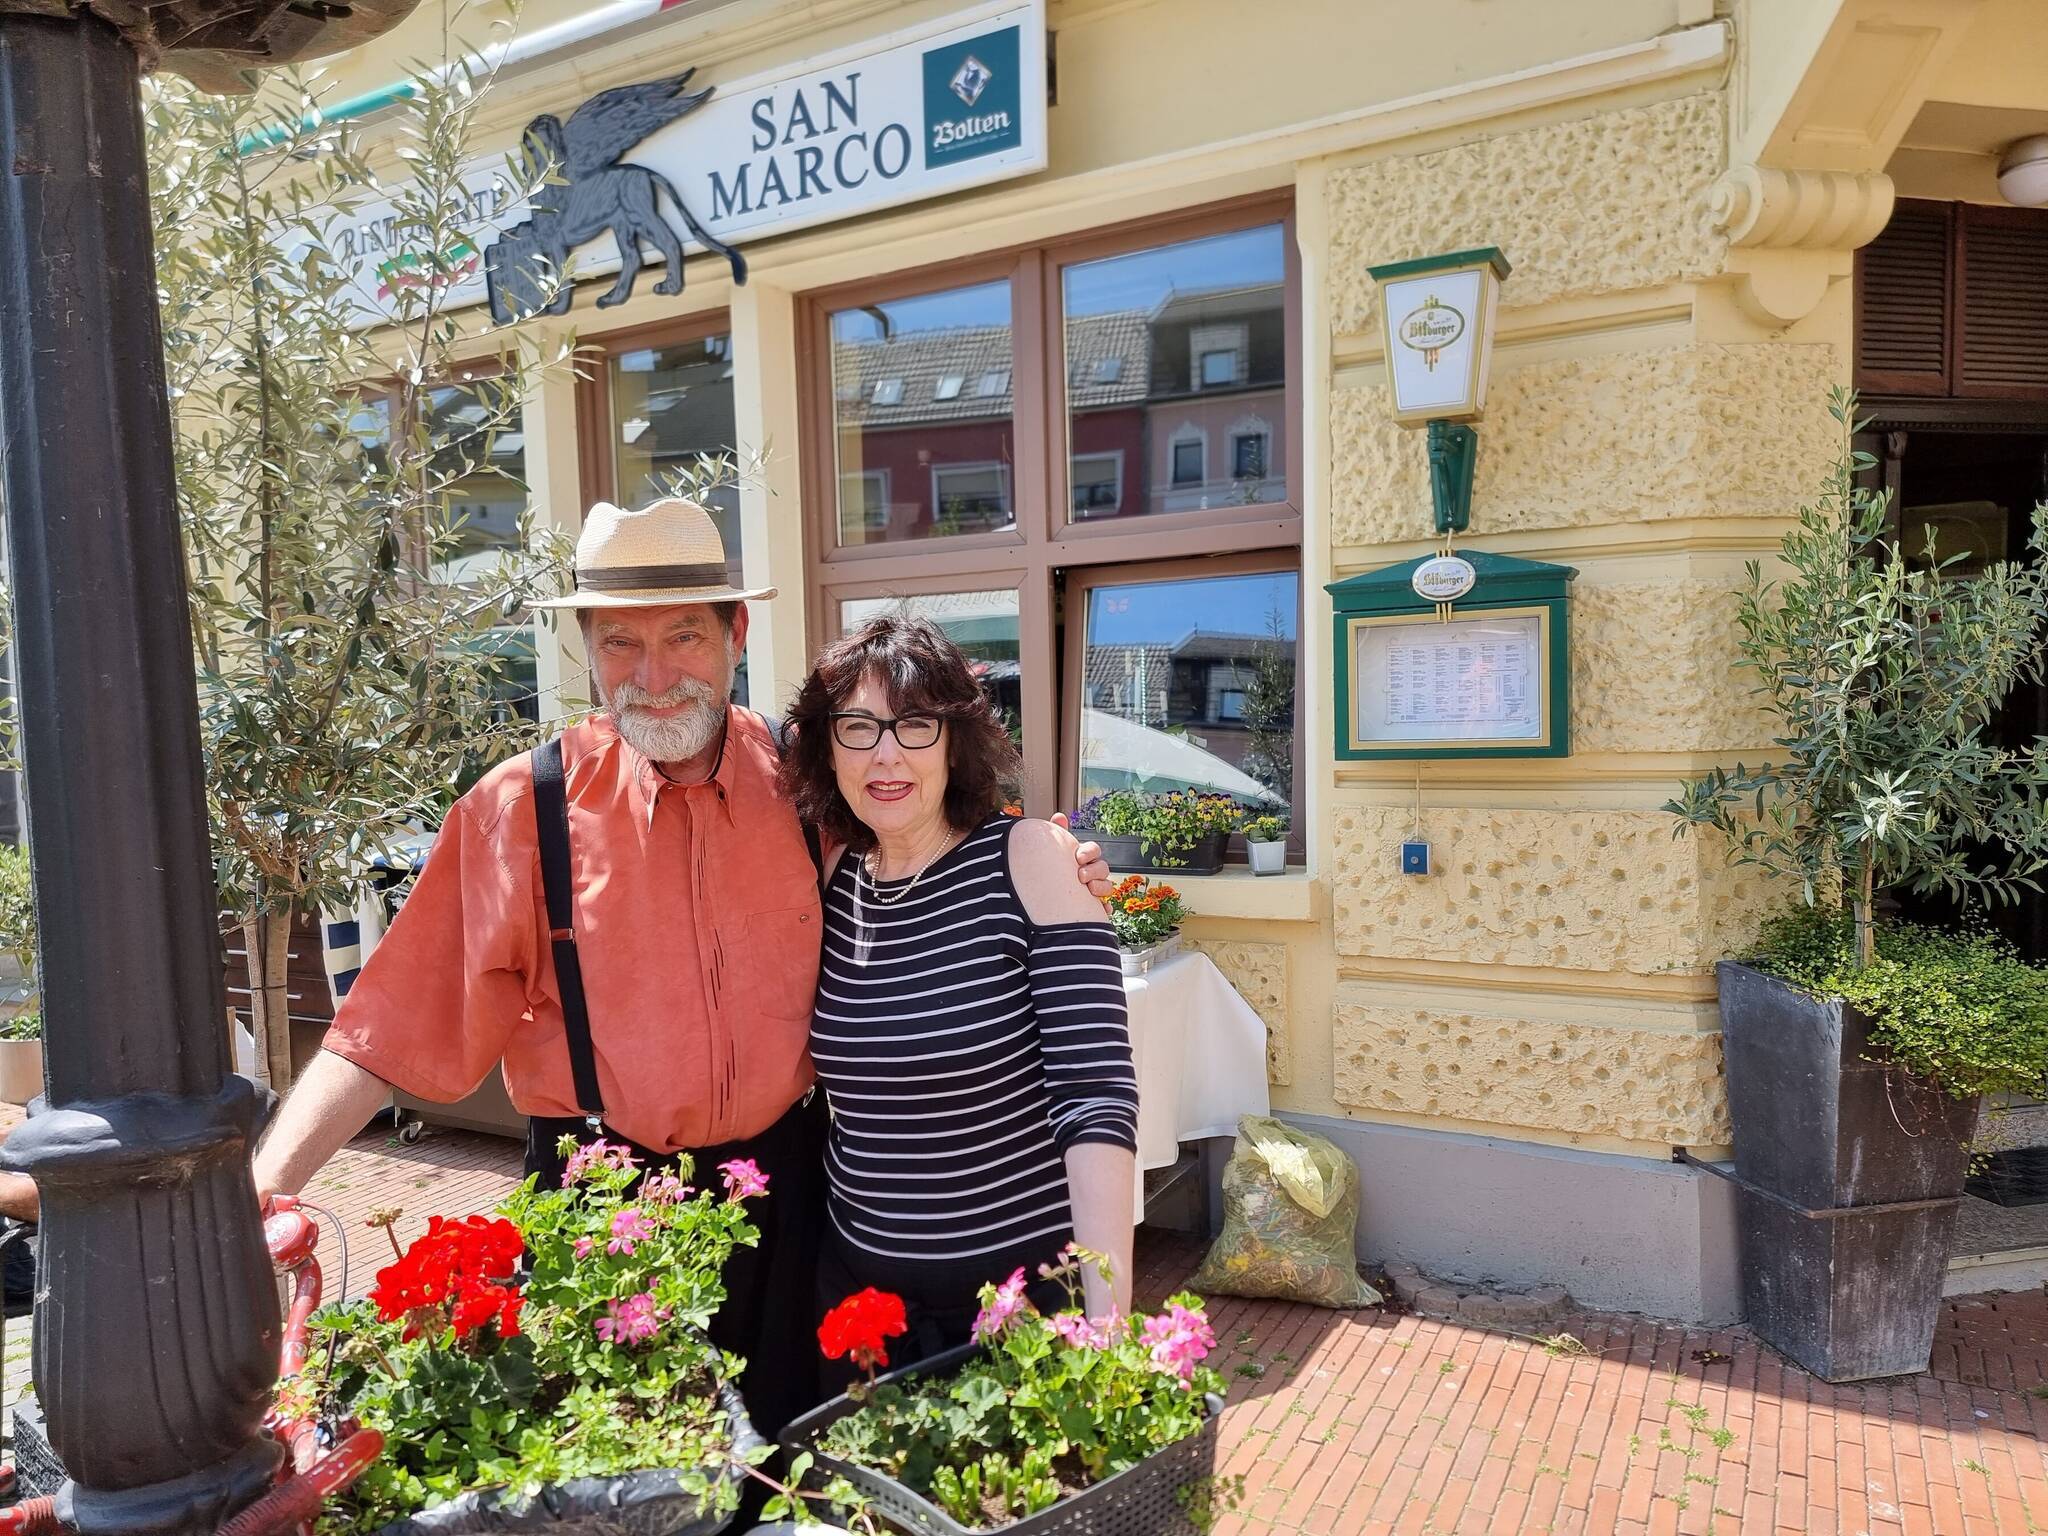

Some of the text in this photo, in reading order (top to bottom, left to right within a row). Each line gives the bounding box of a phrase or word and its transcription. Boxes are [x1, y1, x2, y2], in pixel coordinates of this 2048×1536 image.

[751, 72, 862, 154] SAN
[933, 111, 1012, 149] Bolten
[707, 122, 912, 222] MARCO
